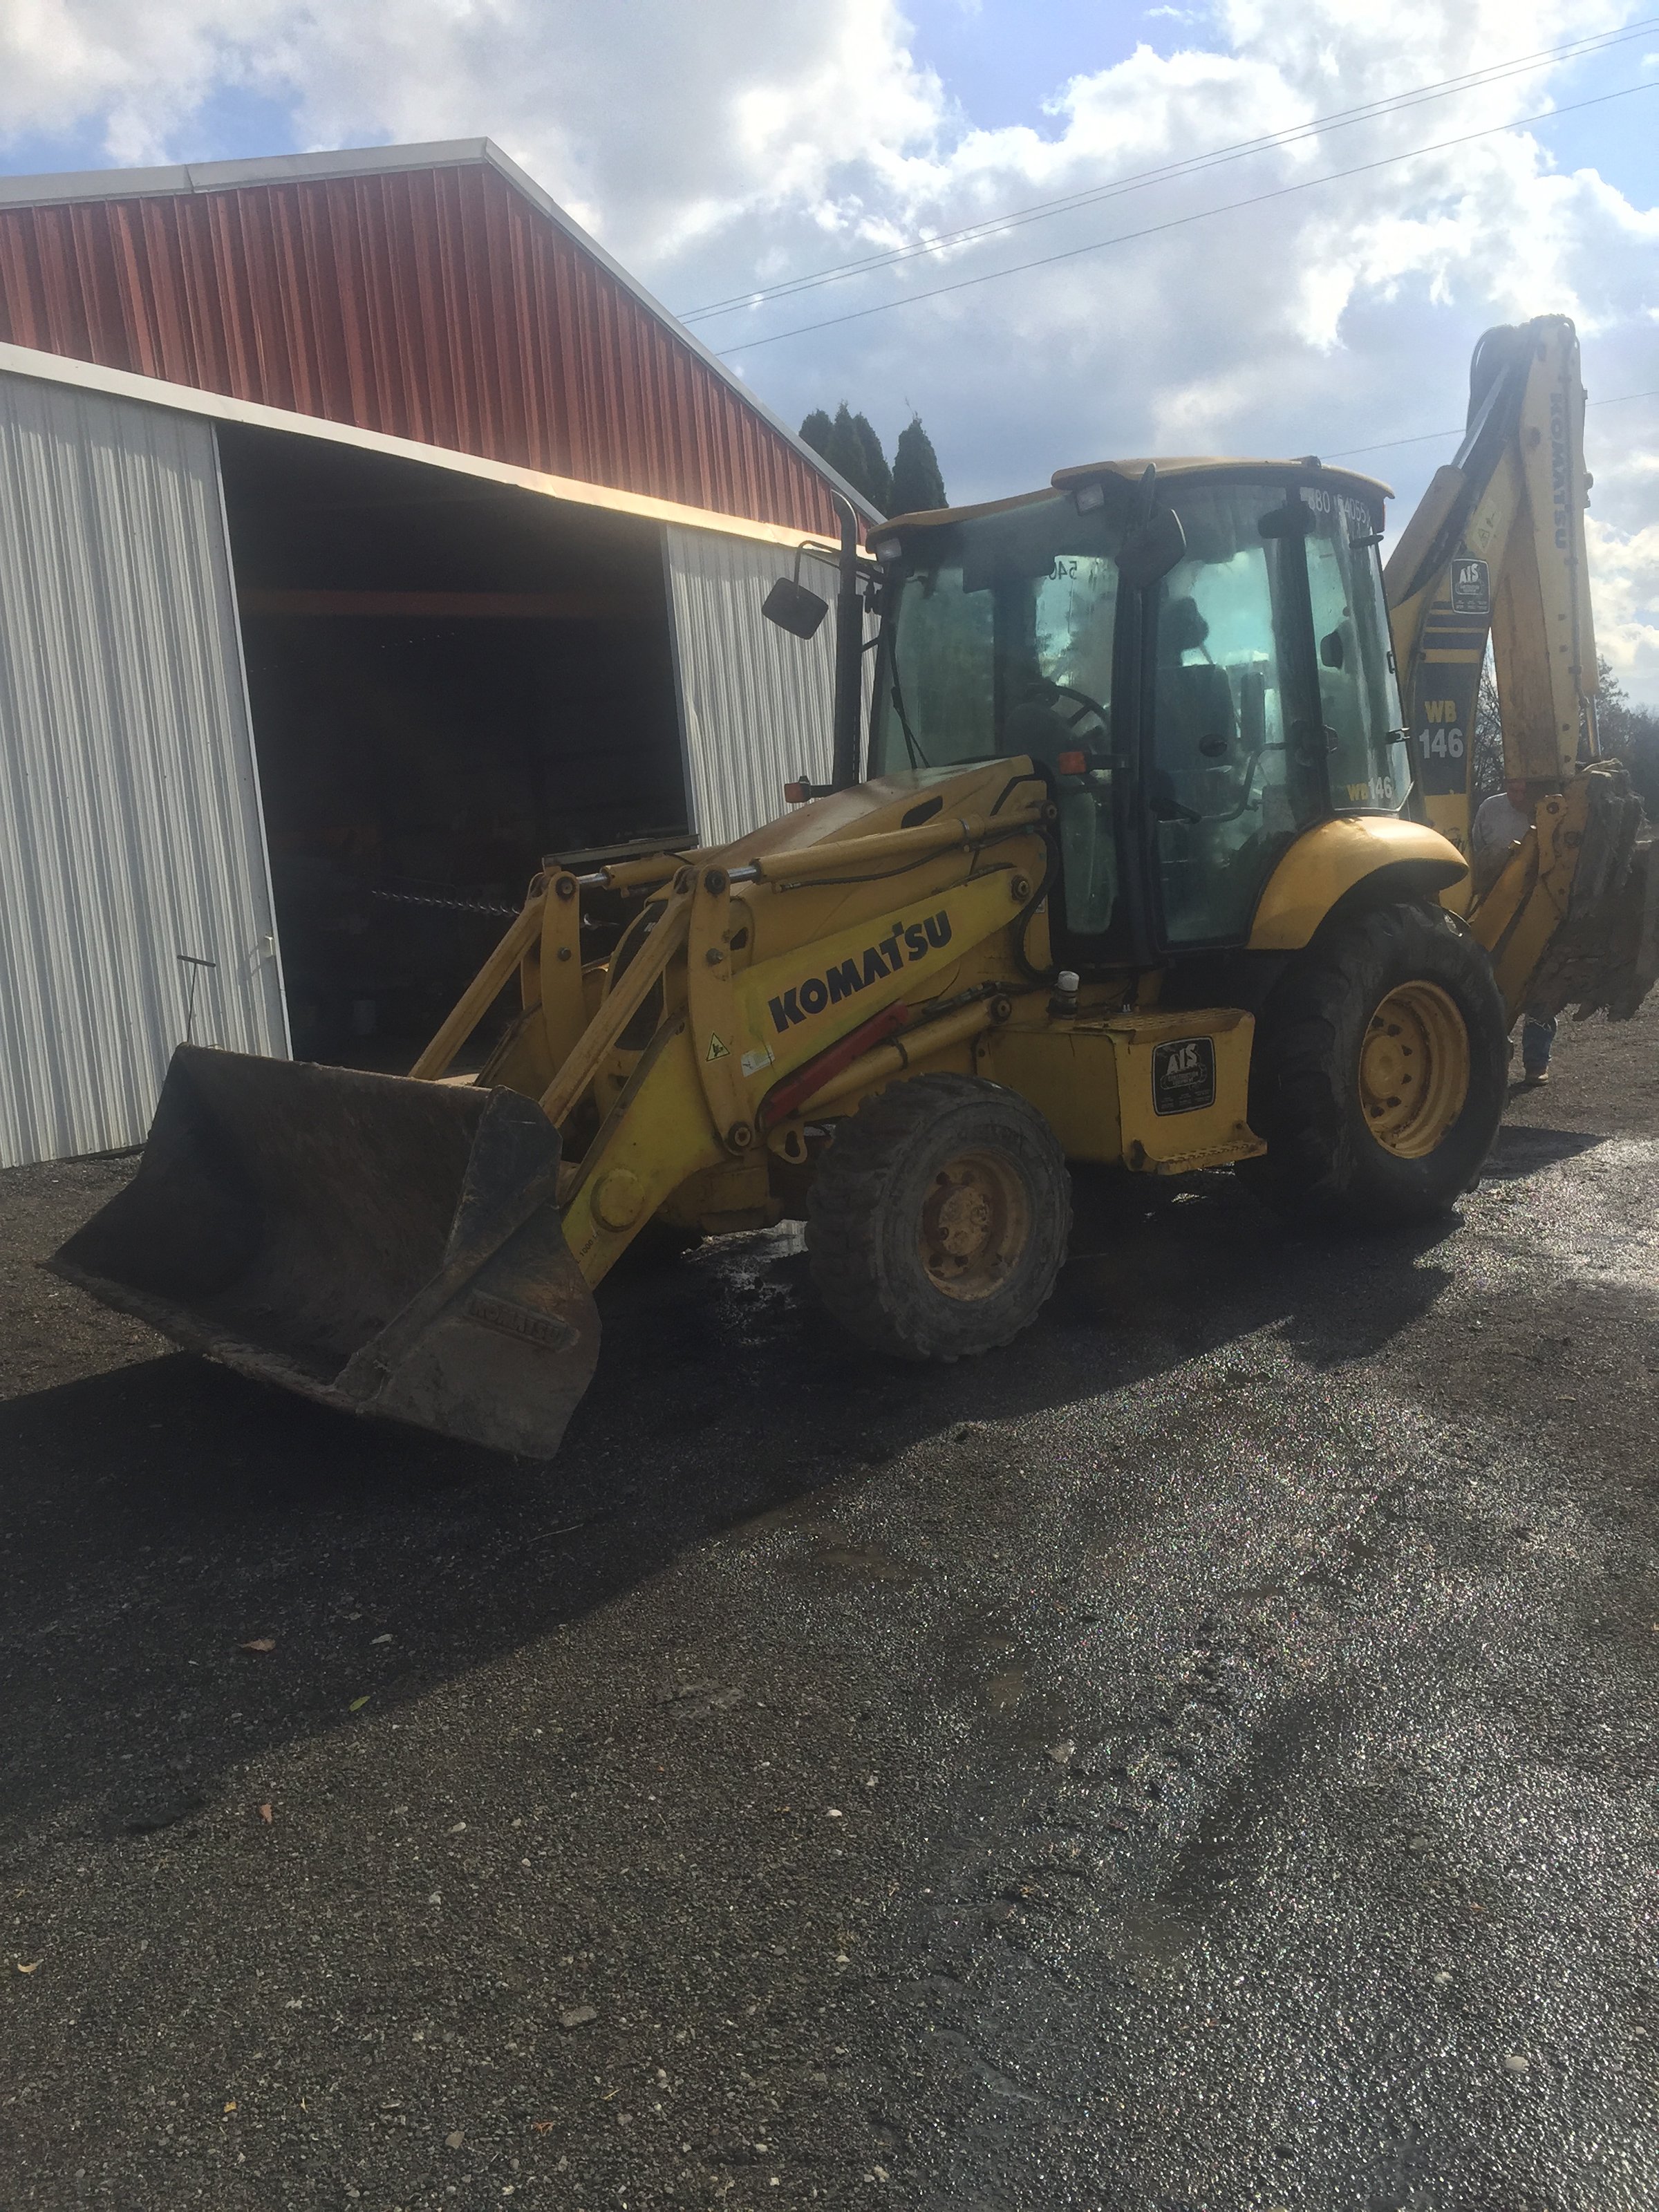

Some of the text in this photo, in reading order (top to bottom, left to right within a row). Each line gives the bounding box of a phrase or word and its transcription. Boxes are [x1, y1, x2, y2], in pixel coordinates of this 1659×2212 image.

[1550, 393, 1570, 549] KOMATSU
[1459, 563, 1479, 583] AIS
[1424, 700, 1456, 723] WB
[1419, 728, 1463, 758] 146
[1347, 776, 1393, 801] WB 146
[767, 910, 952, 1033] KOMATSU
[1167, 1043, 1197, 1076] AIS
[579, 1239, 594, 1257] 1000
